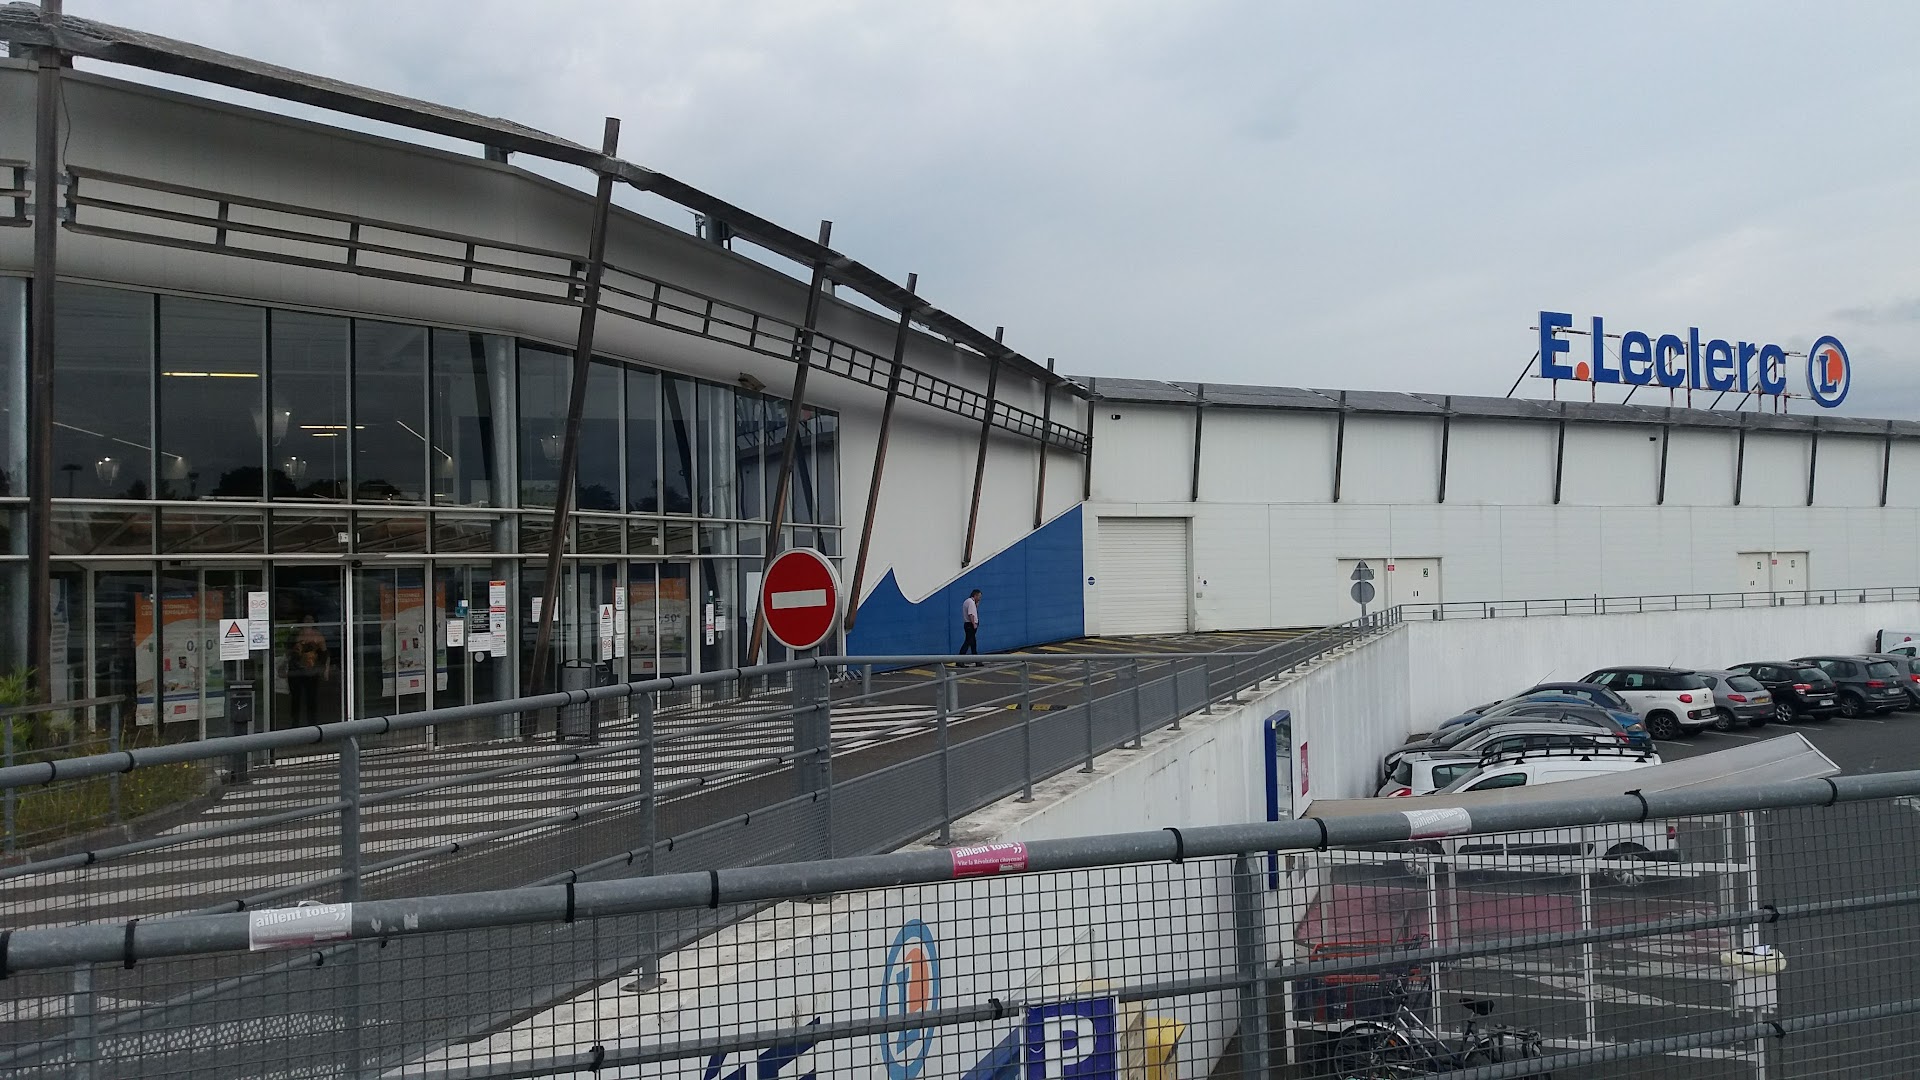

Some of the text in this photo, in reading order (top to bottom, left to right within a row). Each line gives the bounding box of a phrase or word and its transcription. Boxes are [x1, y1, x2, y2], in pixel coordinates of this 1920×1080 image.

[1538, 311, 1786, 394] E.Leclerc
[1414, 813, 1440, 829] aillent
[956, 846, 989, 859] aillent
[256, 909, 302, 928] aillent
[306, 905, 337, 918] tous
[1044, 1014, 1097, 1080] P
